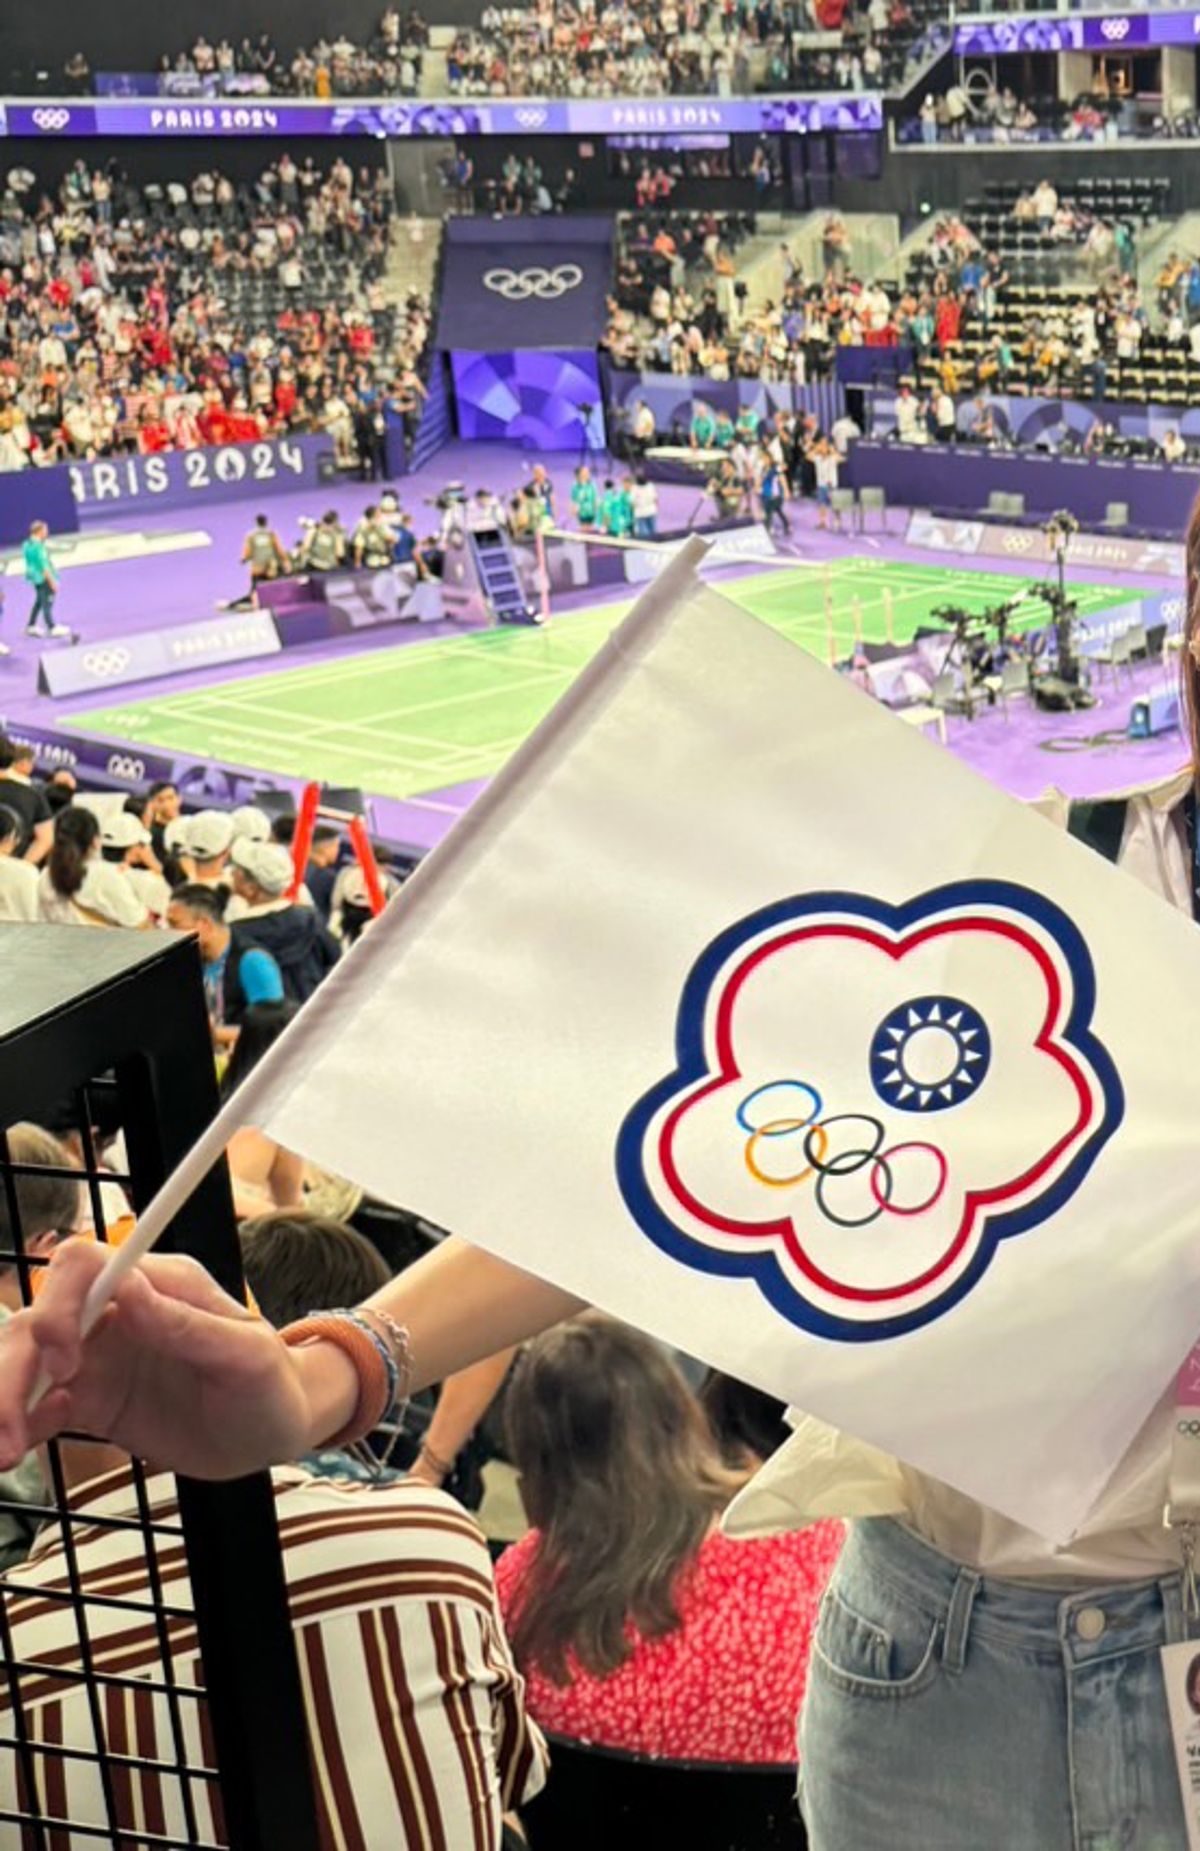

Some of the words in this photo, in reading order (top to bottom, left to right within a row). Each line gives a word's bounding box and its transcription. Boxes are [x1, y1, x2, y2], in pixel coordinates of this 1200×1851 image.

[151, 109, 215, 128] PARIS
[220, 108, 278, 128] 2024
[612, 107, 667, 126] PARIS
[672, 106, 721, 125] 2024
[184, 441, 304, 488] 2024
